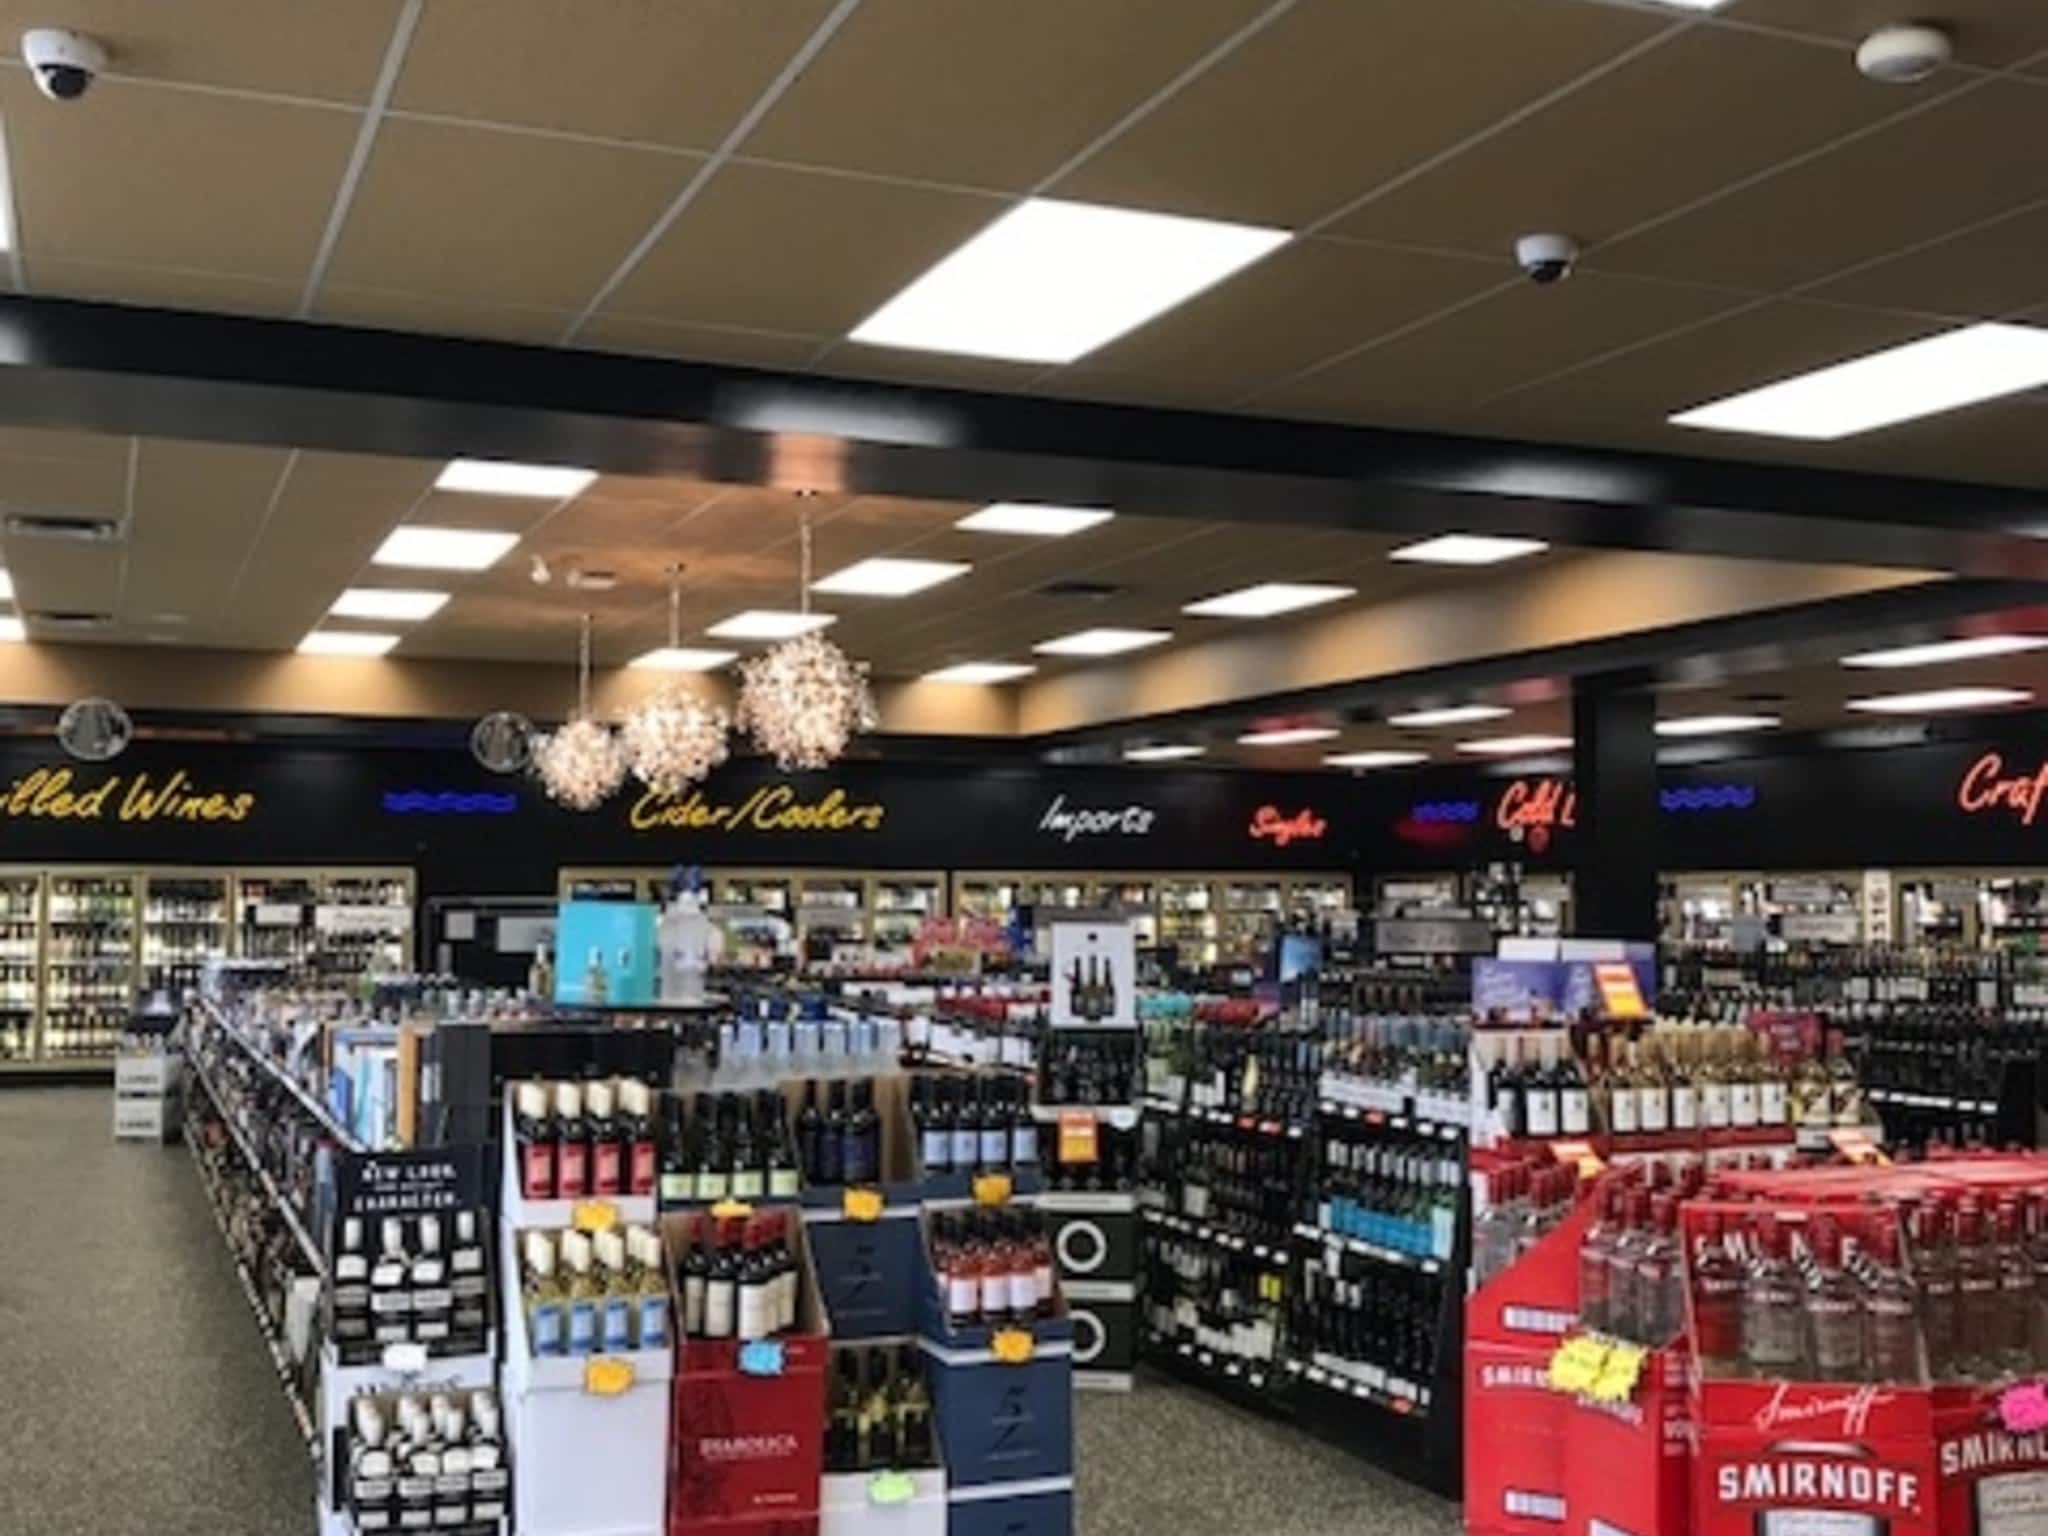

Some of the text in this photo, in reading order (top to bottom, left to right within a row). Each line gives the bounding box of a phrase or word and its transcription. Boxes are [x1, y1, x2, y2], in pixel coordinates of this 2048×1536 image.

[119, 770, 254, 821] Wines
[630, 785, 884, 831] Cider/Coolers
[1040, 794, 1155, 841] Imports
[1249, 805, 1326, 846] Singles
[1481, 1364, 1549, 1389] SMIRN
[1754, 1383, 1896, 1436] Smirnoff
[1717, 1462, 1918, 1510] SMIRNOFF
